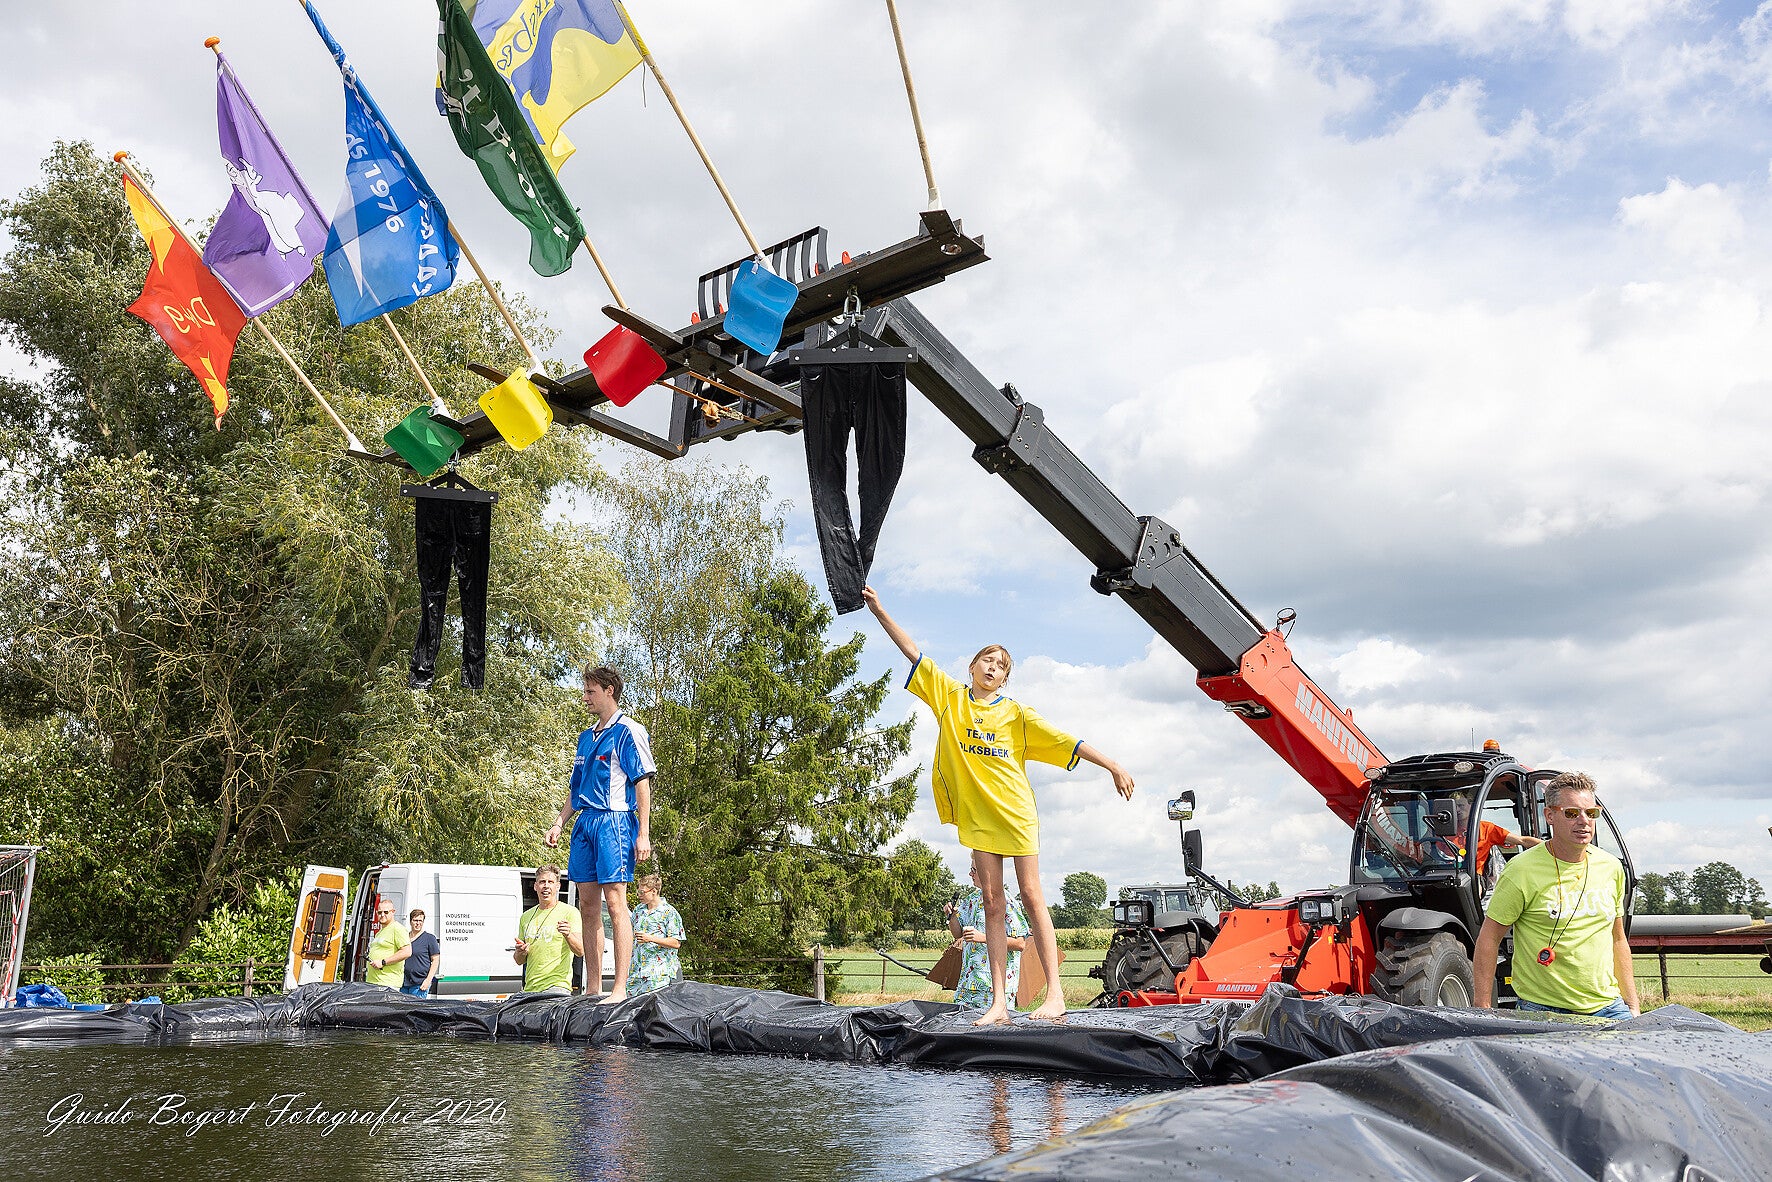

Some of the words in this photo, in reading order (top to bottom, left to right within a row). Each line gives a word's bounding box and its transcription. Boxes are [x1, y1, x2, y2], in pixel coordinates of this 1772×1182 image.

[365, 163, 405, 233] 1976
[966, 728, 995, 742] TEAM
[1295, 681, 1369, 773] MANITOU
[1216, 984, 1258, 993] MANITOU
